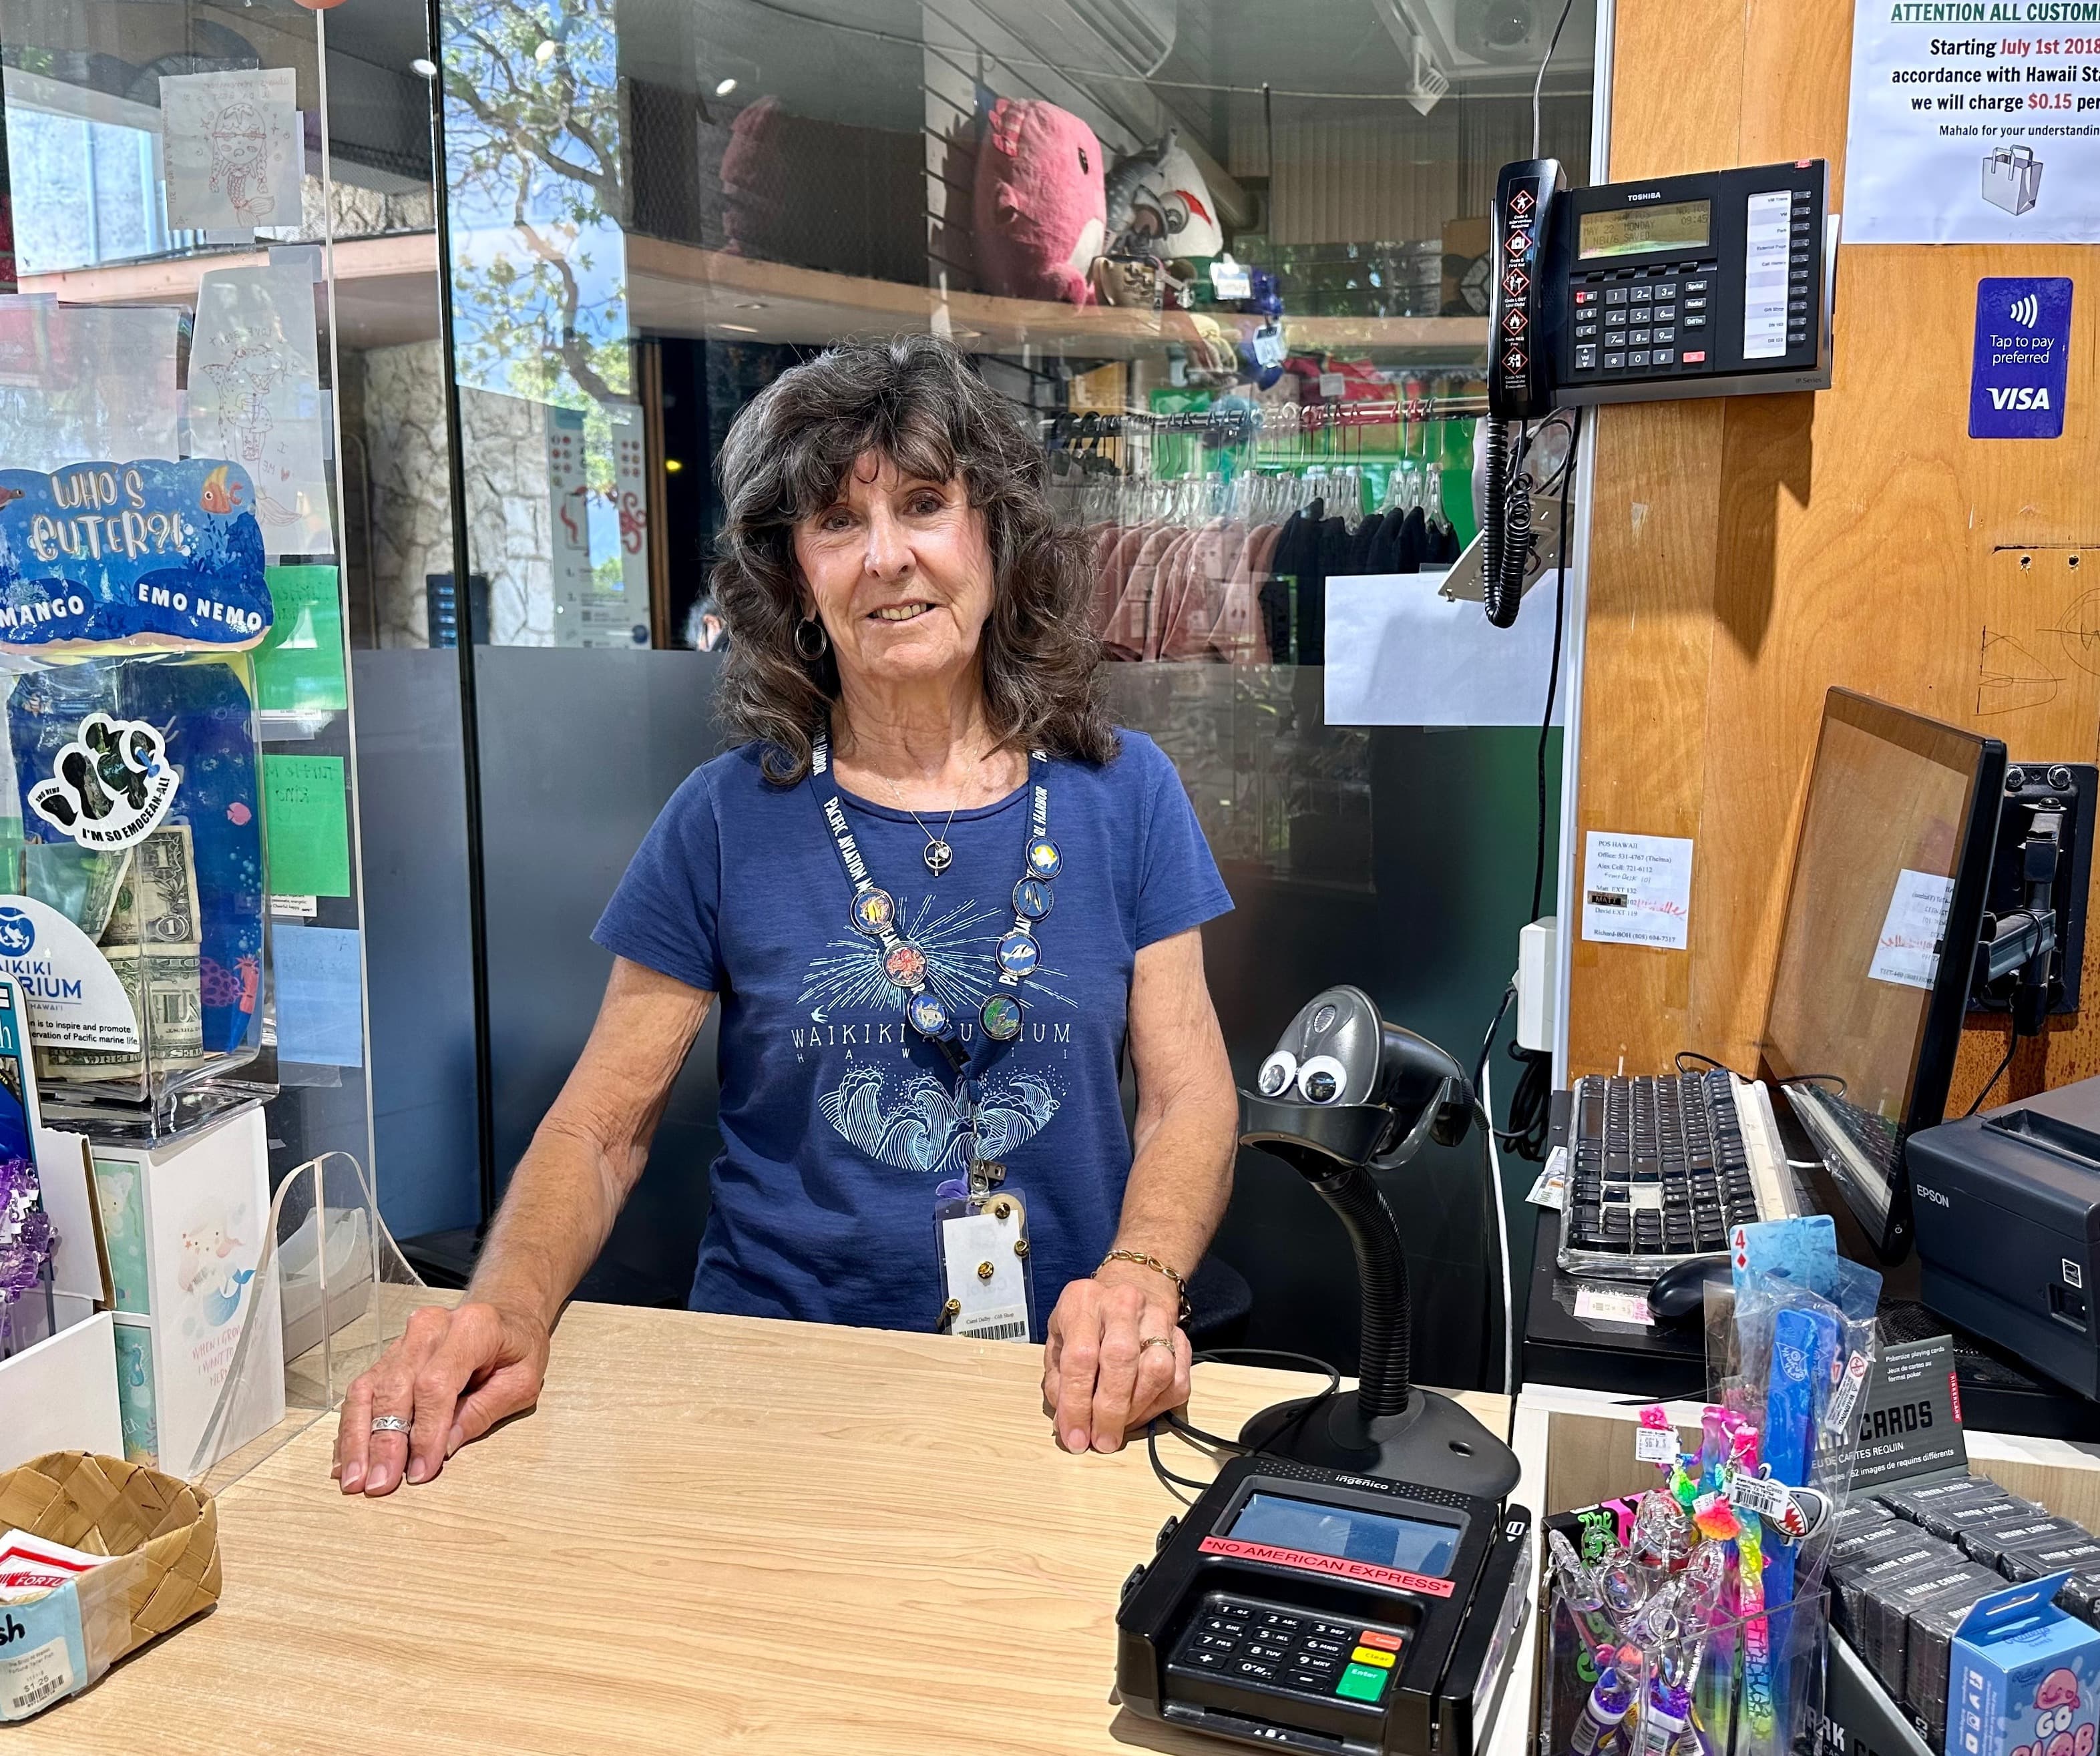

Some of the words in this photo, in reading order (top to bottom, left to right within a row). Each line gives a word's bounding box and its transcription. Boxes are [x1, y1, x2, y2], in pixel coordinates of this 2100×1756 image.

[1891, 3, 1986, 21] ATTENTION
[1990, 3, 2021, 21] ALL
[2027, 3, 2100, 21] CUSTOM
[1930, 39, 1996, 57] Starting
[2000, 38, 2031, 57] July
[2036, 39, 2059, 54] 1st
[2065, 38, 2100, 54] 2018
[1892, 67, 1981, 83] accordance
[1987, 66, 2021, 83] with
[2027, 65, 2077, 81] Hawaii
[1911, 98, 1932, 109] we
[1937, 93, 1963, 109] will
[1969, 93, 2023, 112] charge
[2028, 93, 2072, 109] $0.15
[2077, 97, 2100, 112] per
[1940, 125, 1978, 136] Mahalo
[1982, 124, 1997, 136] for
[2001, 127, 2025, 138] your
[1627, 192, 1661, 201] TOSHIBA
[1584, 227, 1598, 236] MAY
[1603, 224, 1615, 234] 22
[1624, 220, 1655, 232] MONDAY
[1681, 215, 1708, 226] 09:45
[1624, 232, 1650, 242] SAVED
[1637, 290, 1643, 298] 2
[1661, 288, 1667, 296] 3
[1687, 300, 1703, 308] Redial
[1611, 314, 1617, 322] 4
[1635, 312, 1641, 320] 5
[1659, 310, 1666, 318] 6
[1611, 335, 1617, 344] 7
[1635, 333, 1641, 342] 8
[1659, 332, 1665, 340] 9
[1990, 335, 2013, 351] Tap
[2016, 336, 2029, 347] to
[2031, 337, 2055, 351] pay
[1992, 351, 2050, 366] preferred
[1986, 387, 2051, 410] VISA
[51, 469, 145, 509] WHO'S
[0, 595, 85, 628] MANGO
[138, 584, 188, 611] EMO
[196, 598, 262, 631] NEMO
[812, 744, 828, 776] HARBOR
[823, 796, 849, 837] PACIFIC
[837, 834, 867, 881] AVIATION
[1032, 785, 1048, 827] HARBOR
[82, 827, 104, 842] I'M
[107, 829, 122, 842] SO
[37, 1020, 44, 1028] is
[55, 1022, 81, 1032] inspire
[99, 1026, 132, 1034] promote
[31, 1032, 61, 1040] ervation
[63, 1032, 71, 1040] of
[73, 1034, 97, 1042] Pacific
[791, 1023, 905, 1048] WAIKIKI
[1916, 1184, 1950, 1208] EPSON
[1735, 1229, 1745, 1249] 4
[192, 1338, 216, 1361] WHEN
[1911, 1349, 1930, 1359] playing
[1930, 1345, 1945, 1354] cards
[202, 1351, 224, 1374] WANT
[224, 1344, 234, 1359] TO
[1887, 1367, 1900, 1375] Jeux
[1908, 1362, 1924, 1370] cartes
[1888, 1375, 1906, 1383] format
[1906, 1370, 1922, 1379] poker
[1860, 1400, 1932, 1442] CARDS
[1825, 1456, 1837, 1466] DE
[1838, 1448, 1871, 1464] CARTES
[1872, 1442, 1904, 1456] REQUIN
[1861, 1464, 1886, 1476] images
[1886, 1461, 1895, 1470] de
[1896, 1457, 1922, 1468] requins
[1335, 1474, 1389, 1490] ingenico
[1577, 1510, 1612, 1528] The
[1243, 1547, 1345, 1570] AMERICAN
[1211, 1621, 1220, 1629] 4
[1316, 1624, 1325, 1632] 3
[1203, 1636, 1211, 1644] 7
[1259, 1630, 1268, 1638] 5
[1251, 1646, 1261, 1654] 8
[1307, 1640, 1317, 1649] 6
[1319, 1644, 1338, 1652] MNO
[1299, 1656, 1309, 1664] 9
[1365, 1653, 1390, 1662] Clear
[1351, 1668, 1378, 1679] Enter
[2035, 1704, 2074, 1739] GO
